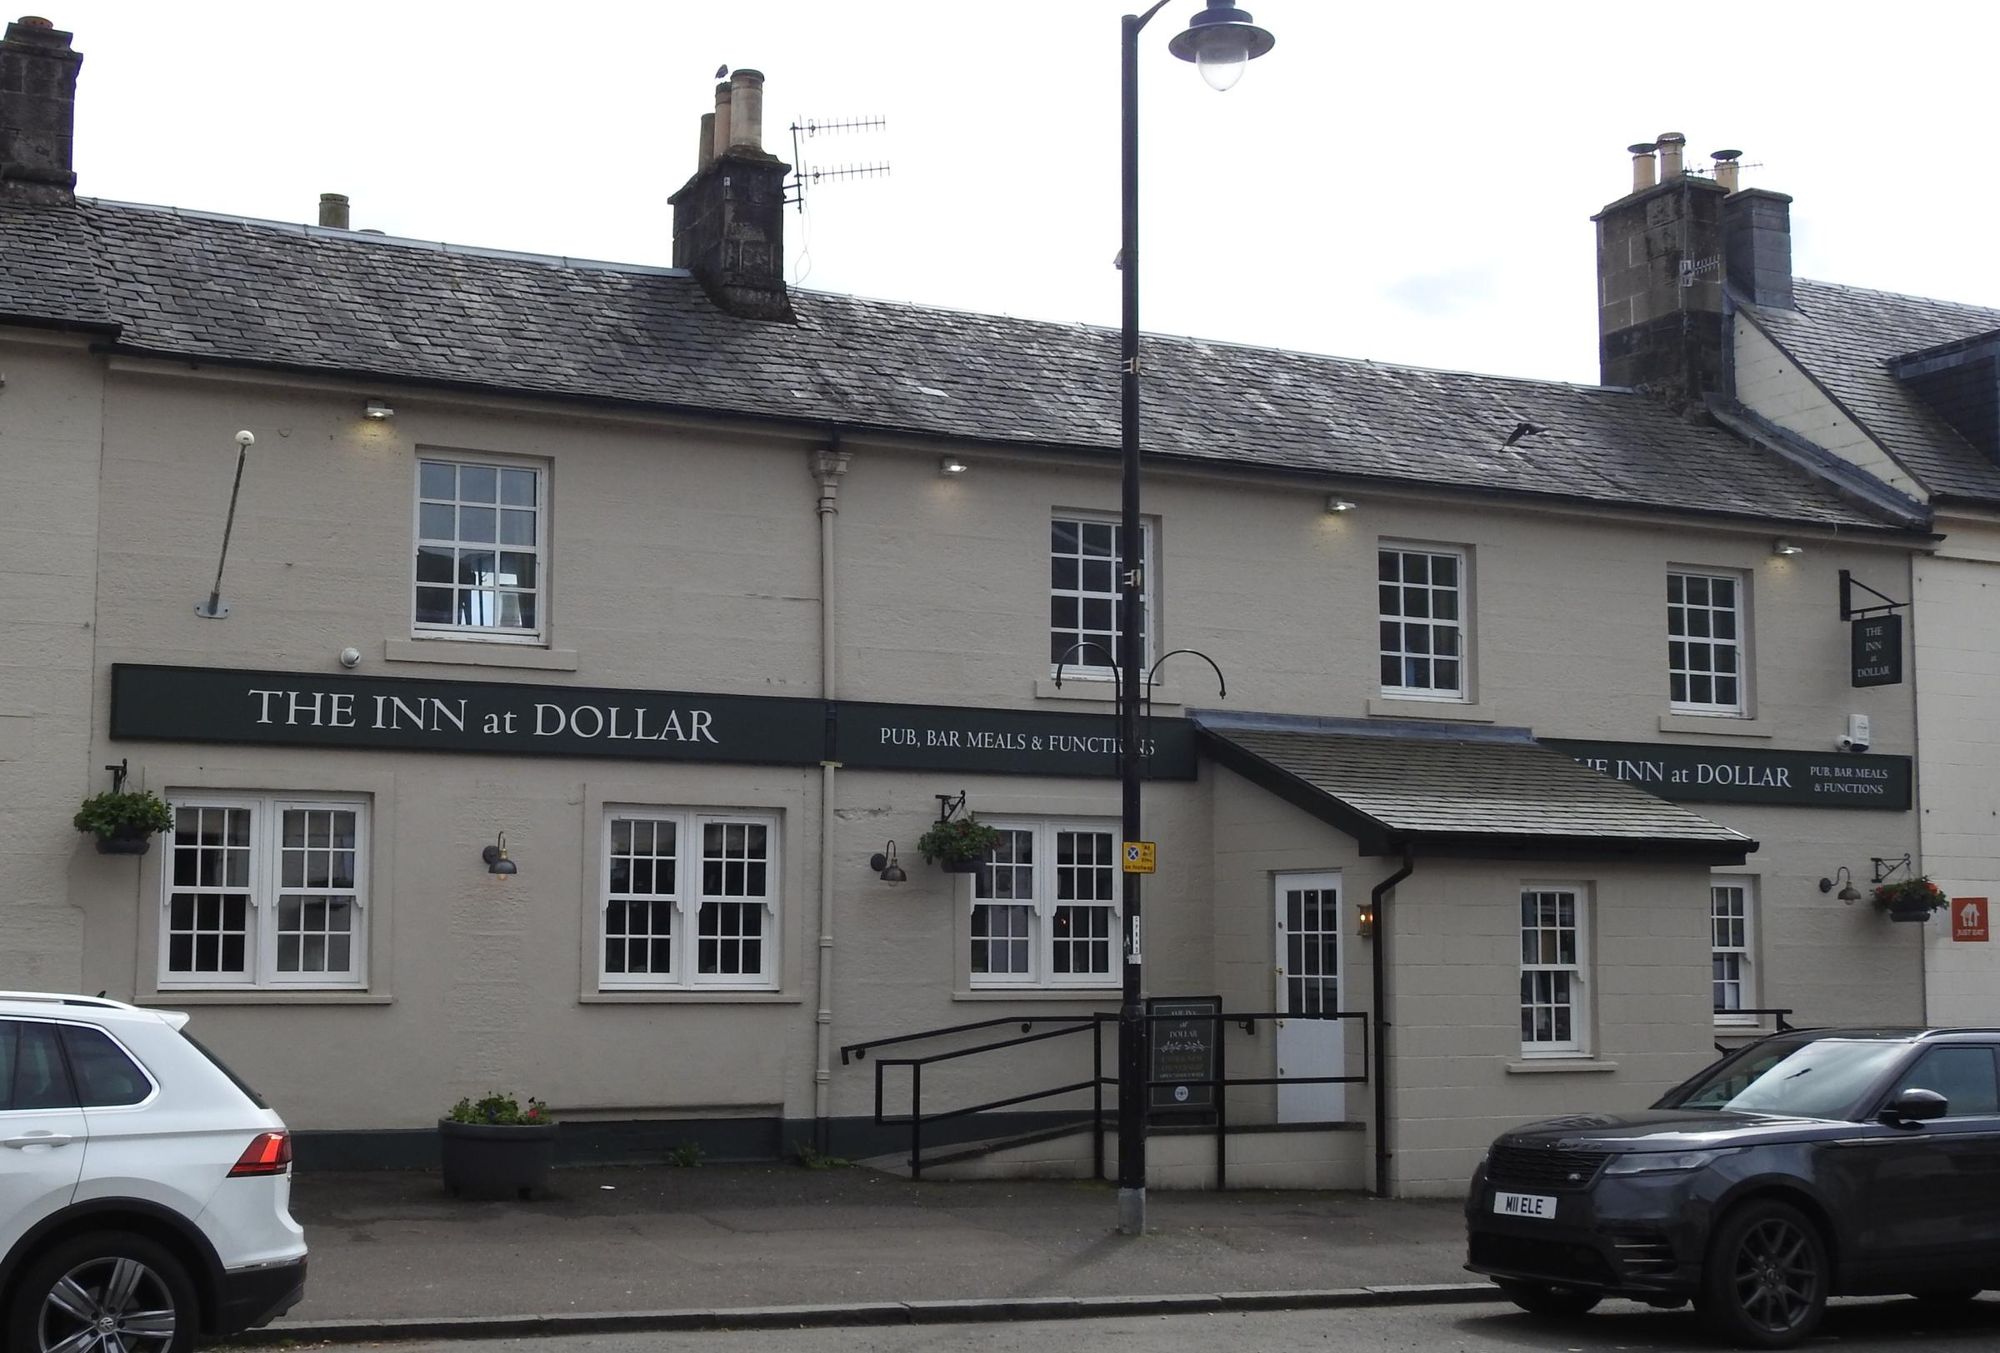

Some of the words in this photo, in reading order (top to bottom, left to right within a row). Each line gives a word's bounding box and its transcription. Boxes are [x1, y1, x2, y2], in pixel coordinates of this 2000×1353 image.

[1864, 626, 1883, 637] THE
[1866, 640, 1882, 652] INN
[1857, 665, 1890, 678] DOLLAR
[248, 689, 356, 728] THE
[371, 695, 468, 732] INN
[482, 708, 517, 736] at
[533, 703, 720, 745] DOLLAR
[880, 727, 920, 749] PUB,
[926, 729, 960, 748] BAR
[967, 731, 1026, 750] MEALS
[1032, 736, 1043, 750] &
[1616, 760, 1664, 782] INN
[1671, 768, 1689, 783] at
[1697, 763, 1792, 788] DOLLAR
[1810, 766, 1832, 779] PUB,
[1834, 767, 1853, 778] BAR
[1855, 769, 1889, 779] MEALS
[1814, 783, 1822, 792] &
[1823, 783, 1884, 795] FUNCTIONS
